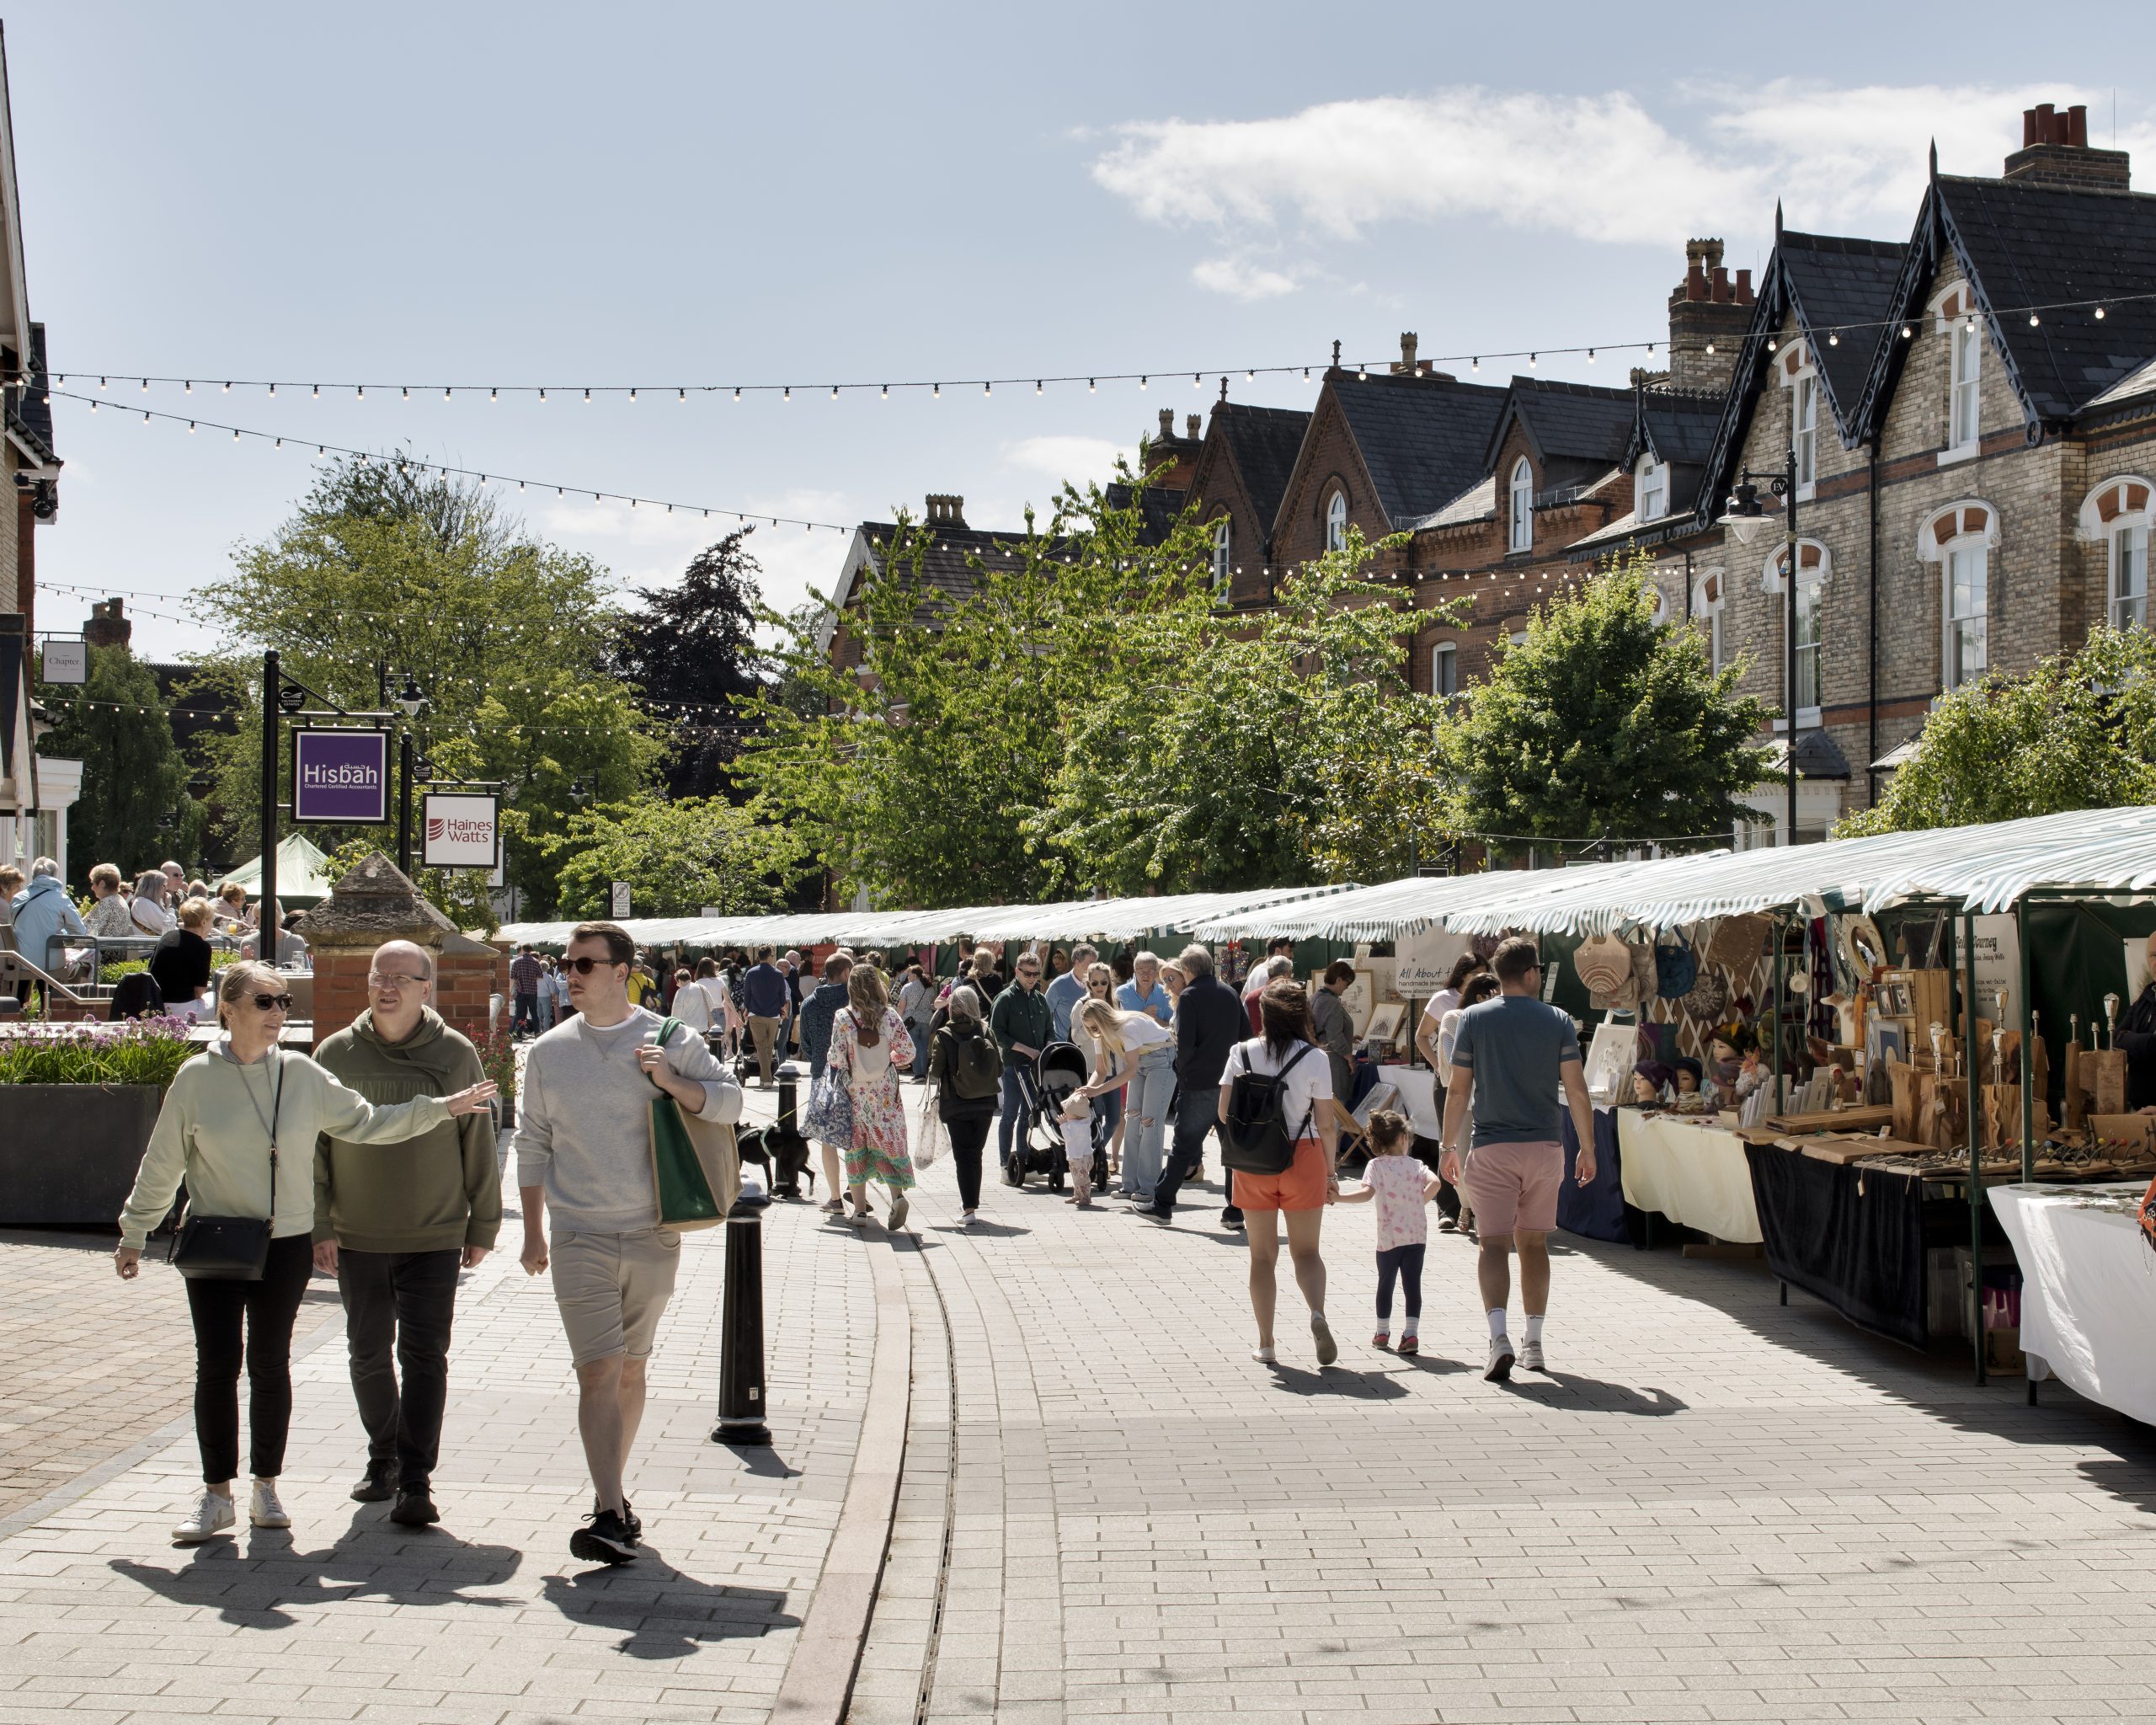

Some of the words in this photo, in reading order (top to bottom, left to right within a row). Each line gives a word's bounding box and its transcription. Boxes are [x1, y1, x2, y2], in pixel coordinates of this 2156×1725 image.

[1773, 483, 1785, 492] EV
[49, 656, 82, 666] Chapter.
[304, 764, 377, 784] Hisbah
[447, 819, 493, 831] Haines
[447, 830, 488, 842] Watts
[1398, 967, 1412, 979] All
[1414, 966, 1443, 979] About
